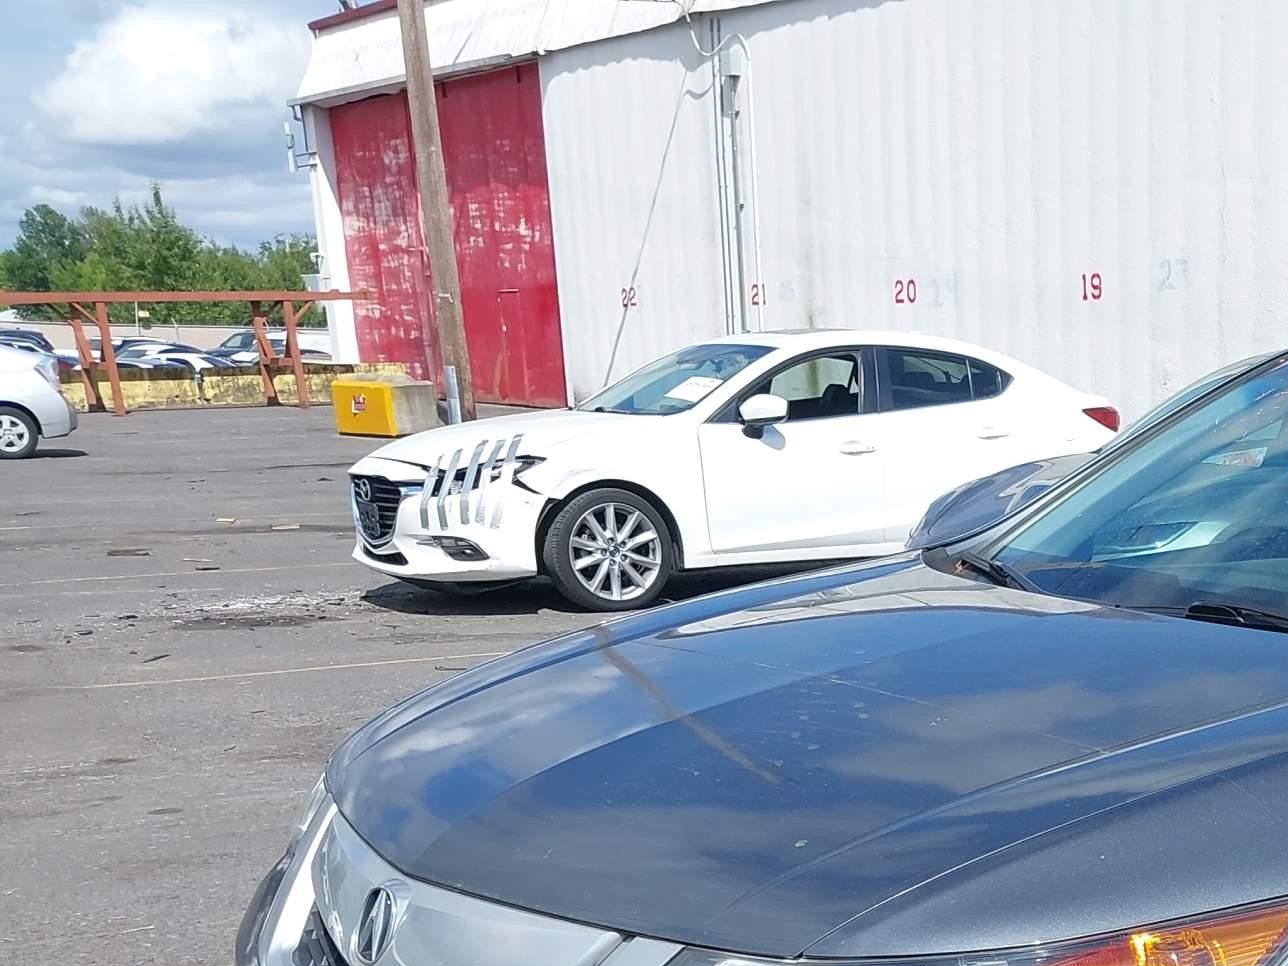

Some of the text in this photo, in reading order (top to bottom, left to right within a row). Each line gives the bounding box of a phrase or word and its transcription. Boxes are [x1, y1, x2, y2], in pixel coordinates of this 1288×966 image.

[621, 286, 638, 308] 22
[751, 283, 767, 306] 21
[894, 279, 918, 304] 20
[1081, 273, 1102, 301] 19
